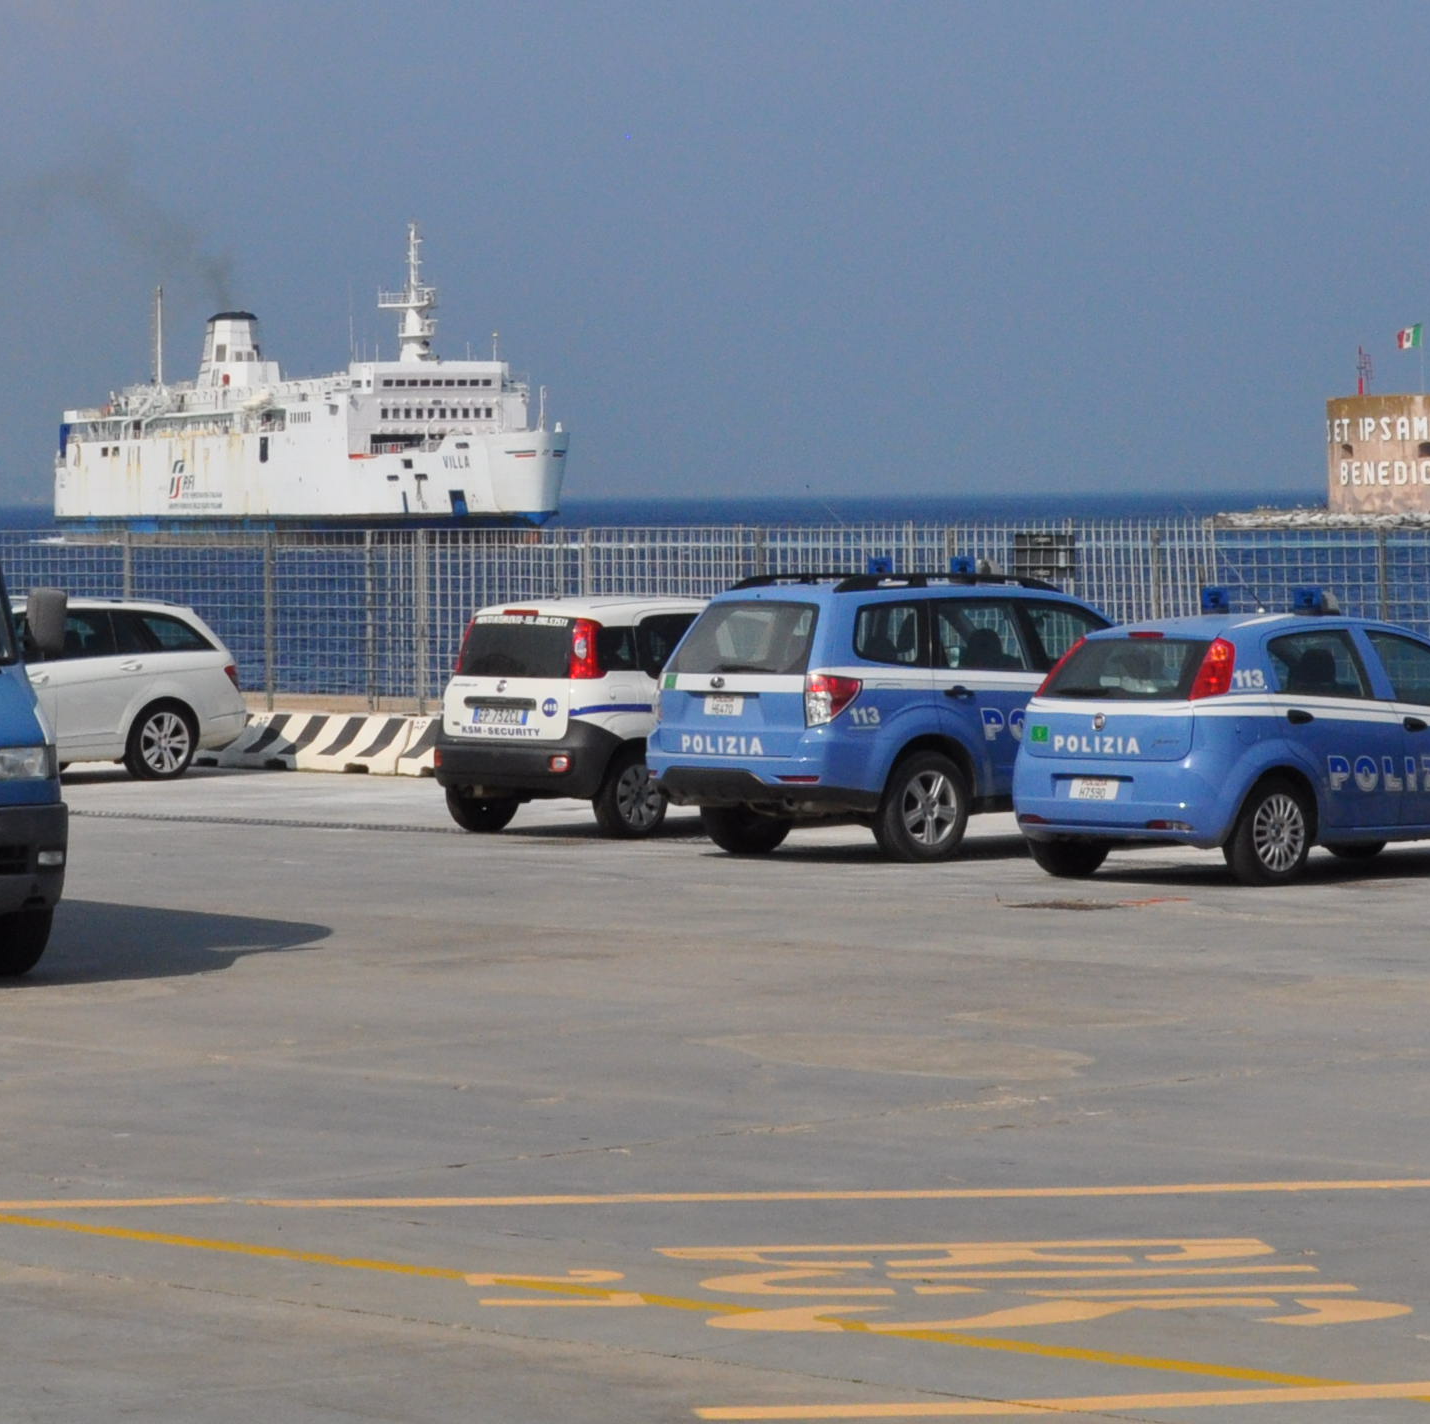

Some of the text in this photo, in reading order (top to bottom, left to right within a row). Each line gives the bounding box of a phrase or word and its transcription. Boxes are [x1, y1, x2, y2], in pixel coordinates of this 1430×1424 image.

[1334, 418, 1350, 443] ET
[1359, 416, 1429, 441] IPSAM
[443, 455, 470, 469] VILLA
[1234, 669, 1264, 688] 113
[850, 707, 880, 725] 113
[462, 725, 482, 734] KSM
[489, 727, 541, 736] SECURITY
[682, 734, 763, 755] POLIZIA
[1054, 735, 1141, 755] POLIZIA
[653, 1237, 1414, 1332] BUS
